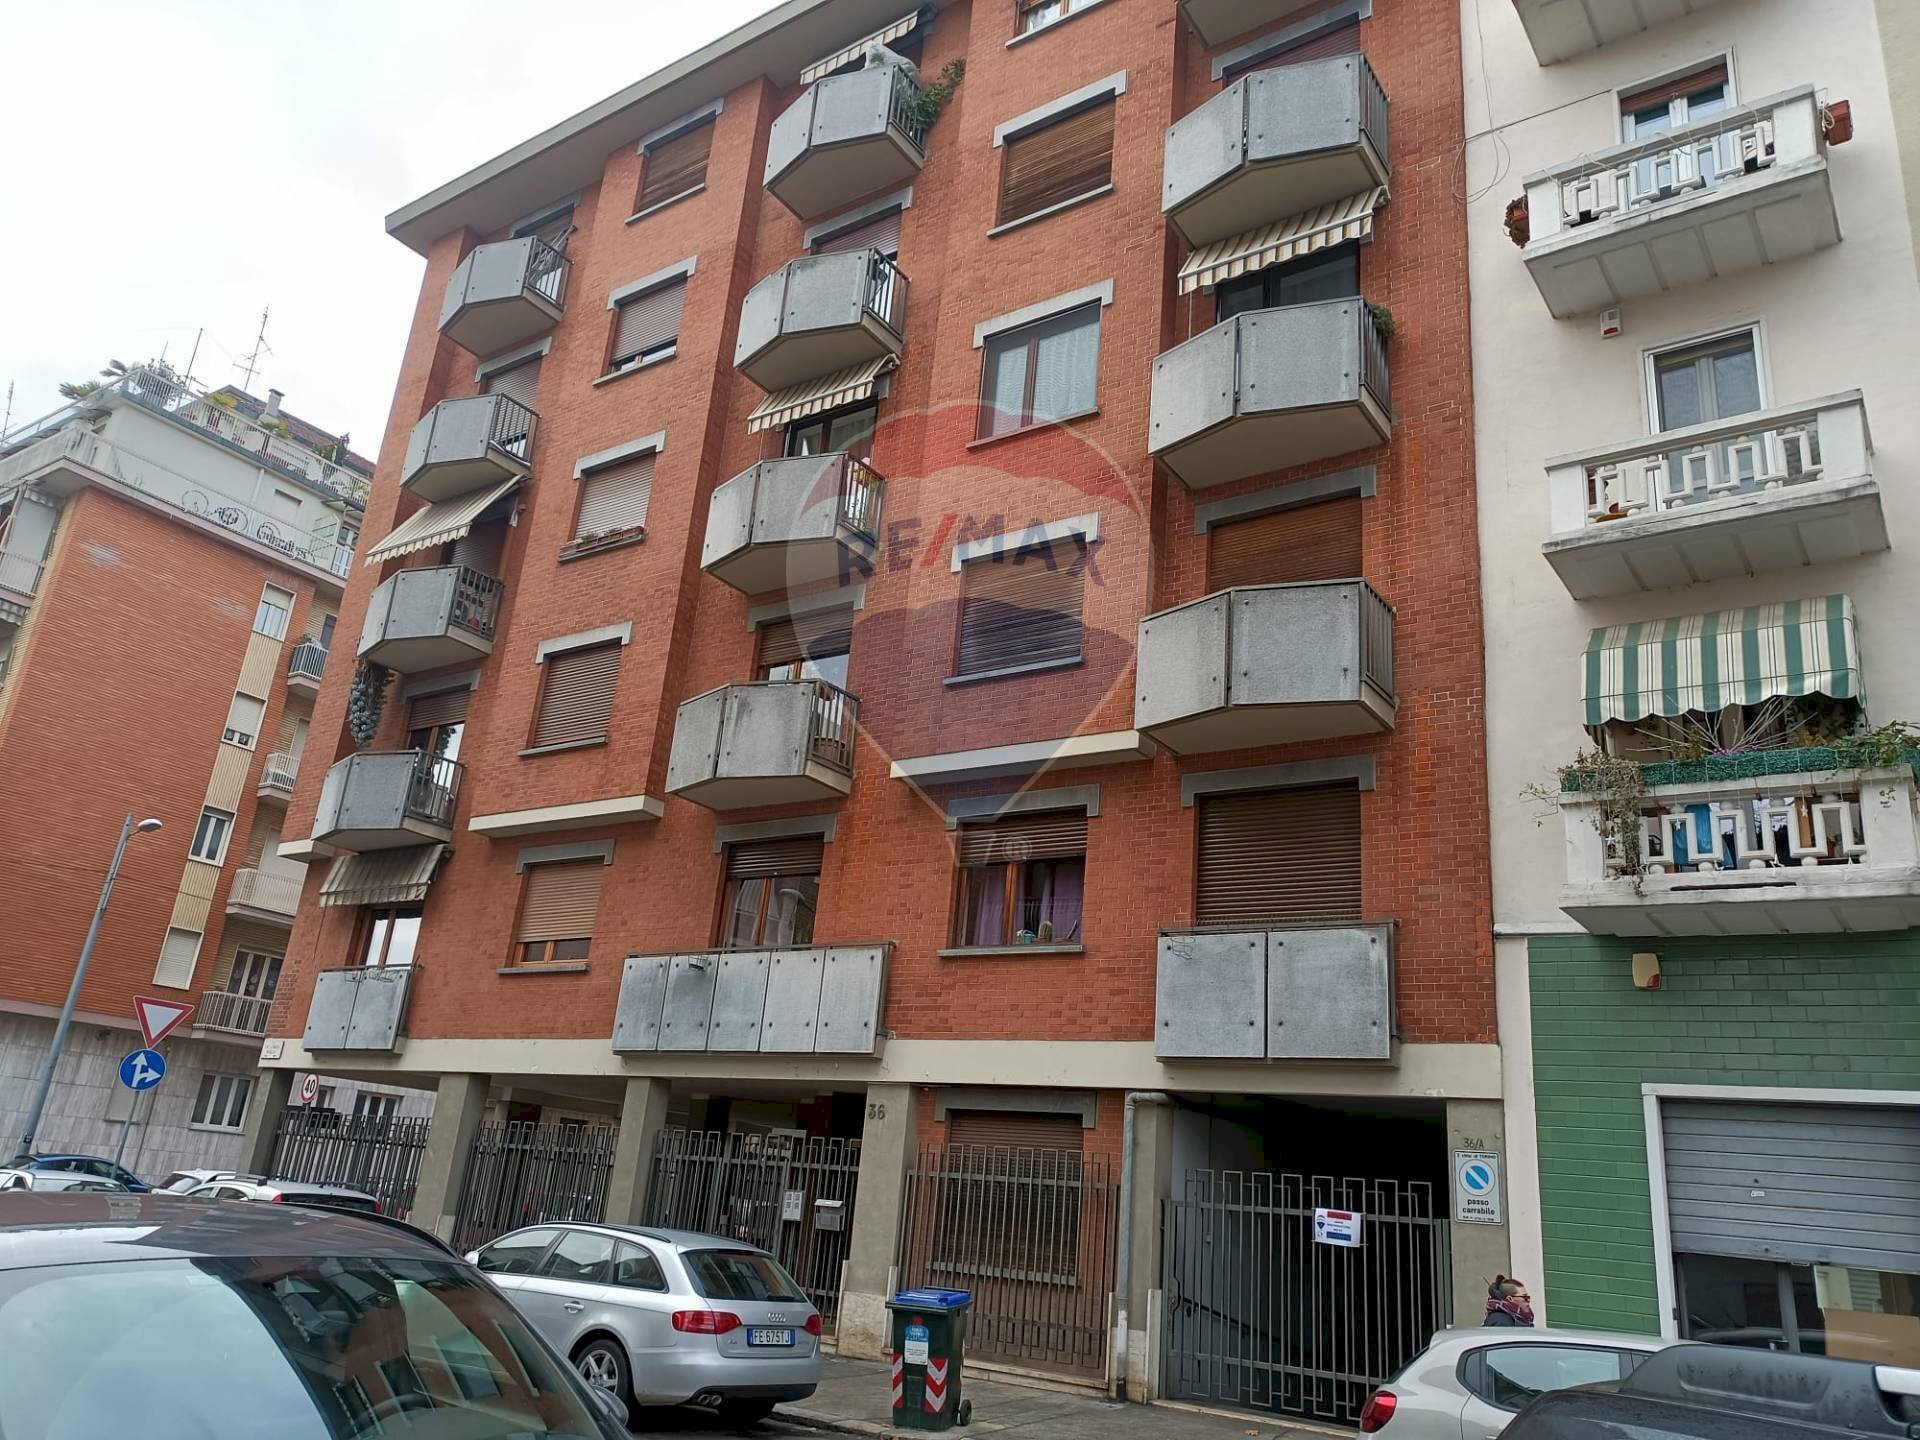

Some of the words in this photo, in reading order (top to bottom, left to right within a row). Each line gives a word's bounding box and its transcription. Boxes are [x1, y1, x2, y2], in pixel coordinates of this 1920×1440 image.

[304, 1079, 316, 1094] 40
[868, 1103, 886, 1120] 36
[1463, 1138, 1485, 1150] 36/A
[1462, 1206, 1496, 1216] carrabile
[754, 1331, 764, 1343] FE
[765, 1331, 790, 1343] 675TJ
